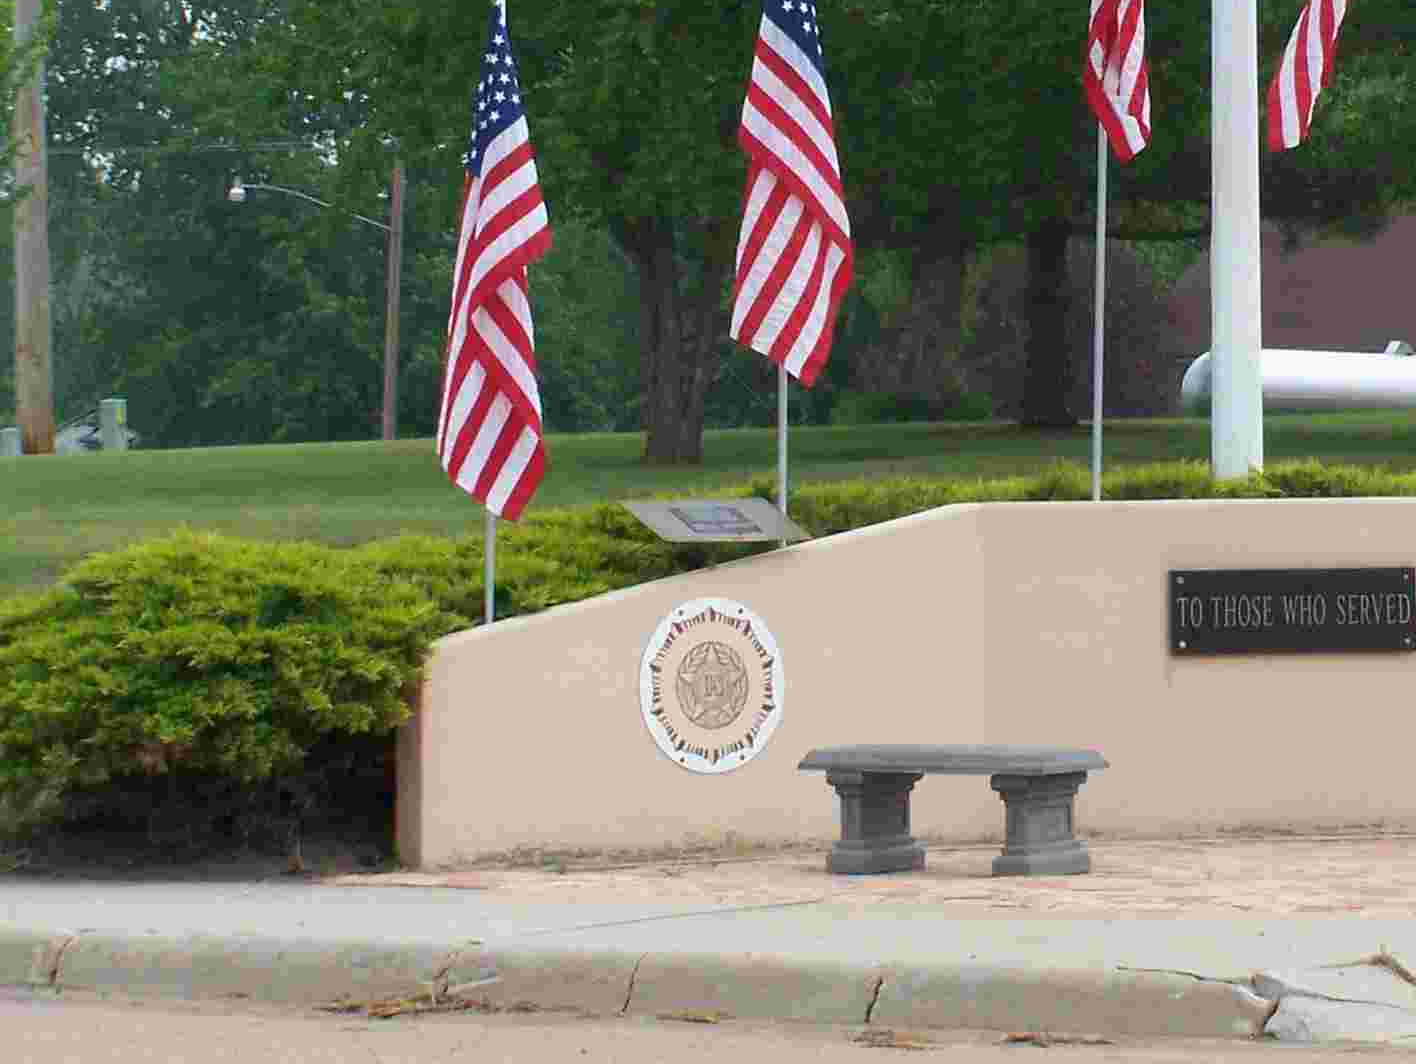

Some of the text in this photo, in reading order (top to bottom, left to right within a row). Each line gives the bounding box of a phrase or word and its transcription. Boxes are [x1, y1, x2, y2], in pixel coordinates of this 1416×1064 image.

[1175, 592, 1410, 628] TO THOSE WHO SERVED
